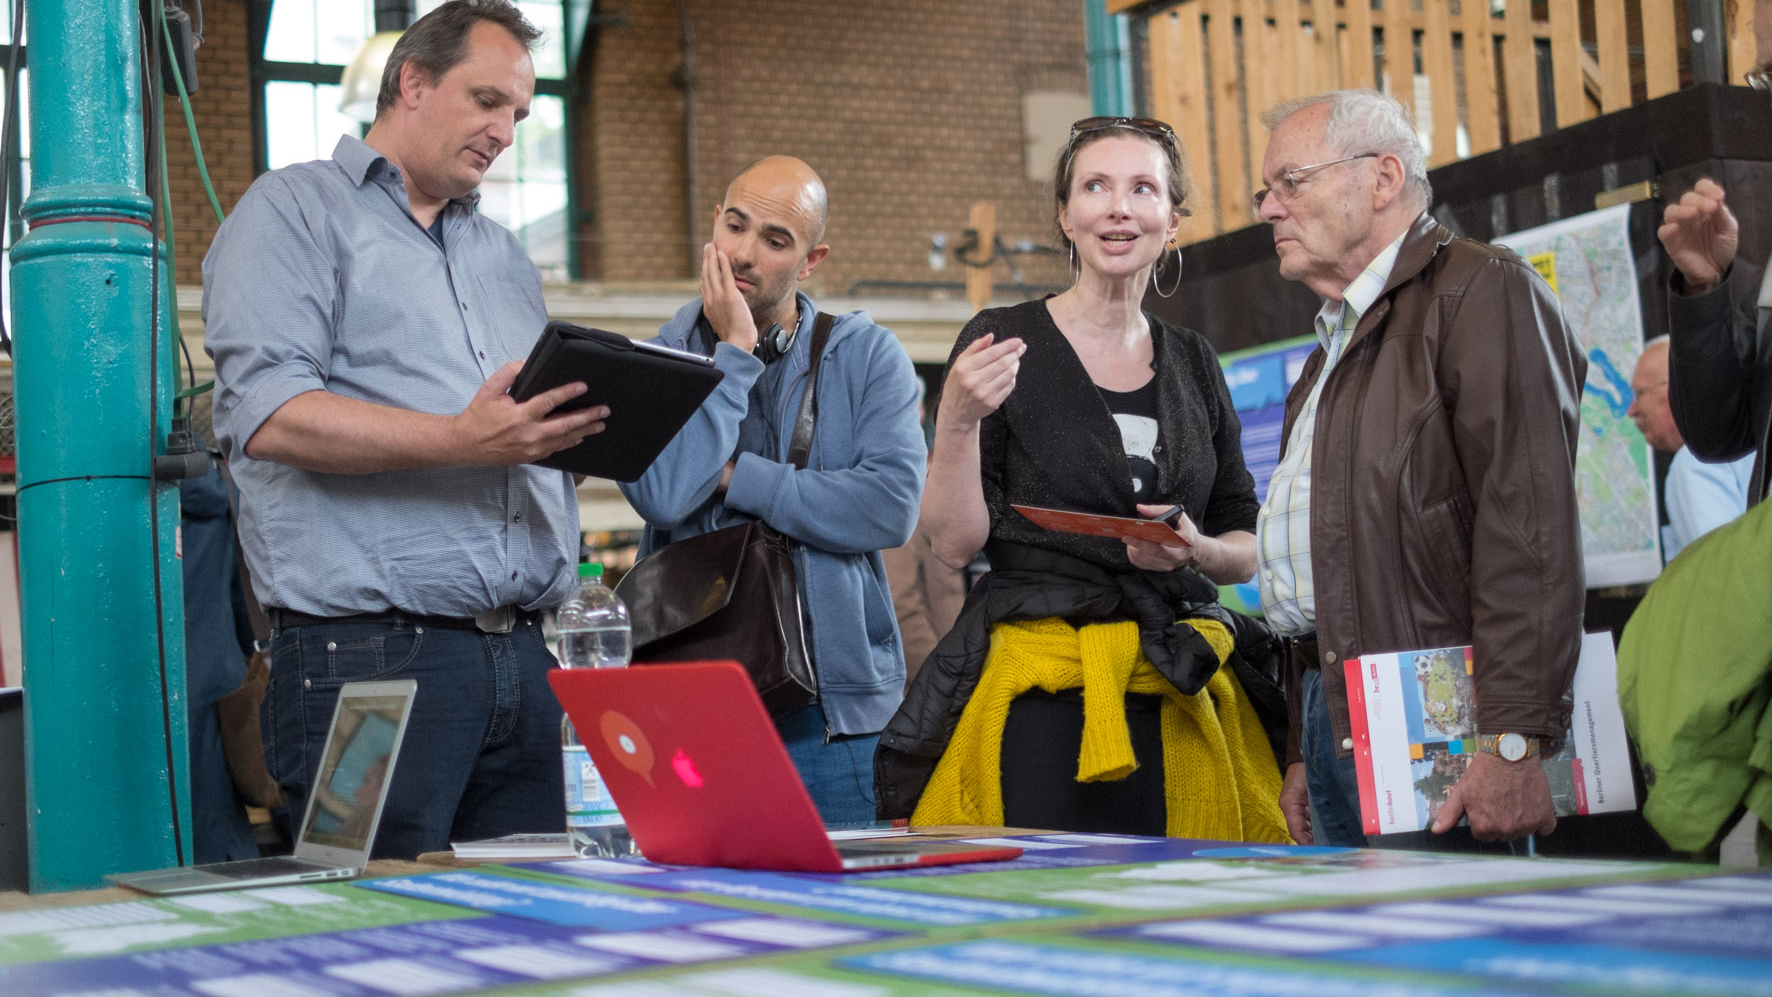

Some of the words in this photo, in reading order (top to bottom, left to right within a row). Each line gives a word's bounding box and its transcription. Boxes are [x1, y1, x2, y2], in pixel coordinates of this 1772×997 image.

[1584, 700, 1601, 776] Quartiersmanagement
[1385, 789, 1396, 825] berlinbaut
[1596, 777, 1604, 804] Berliner
